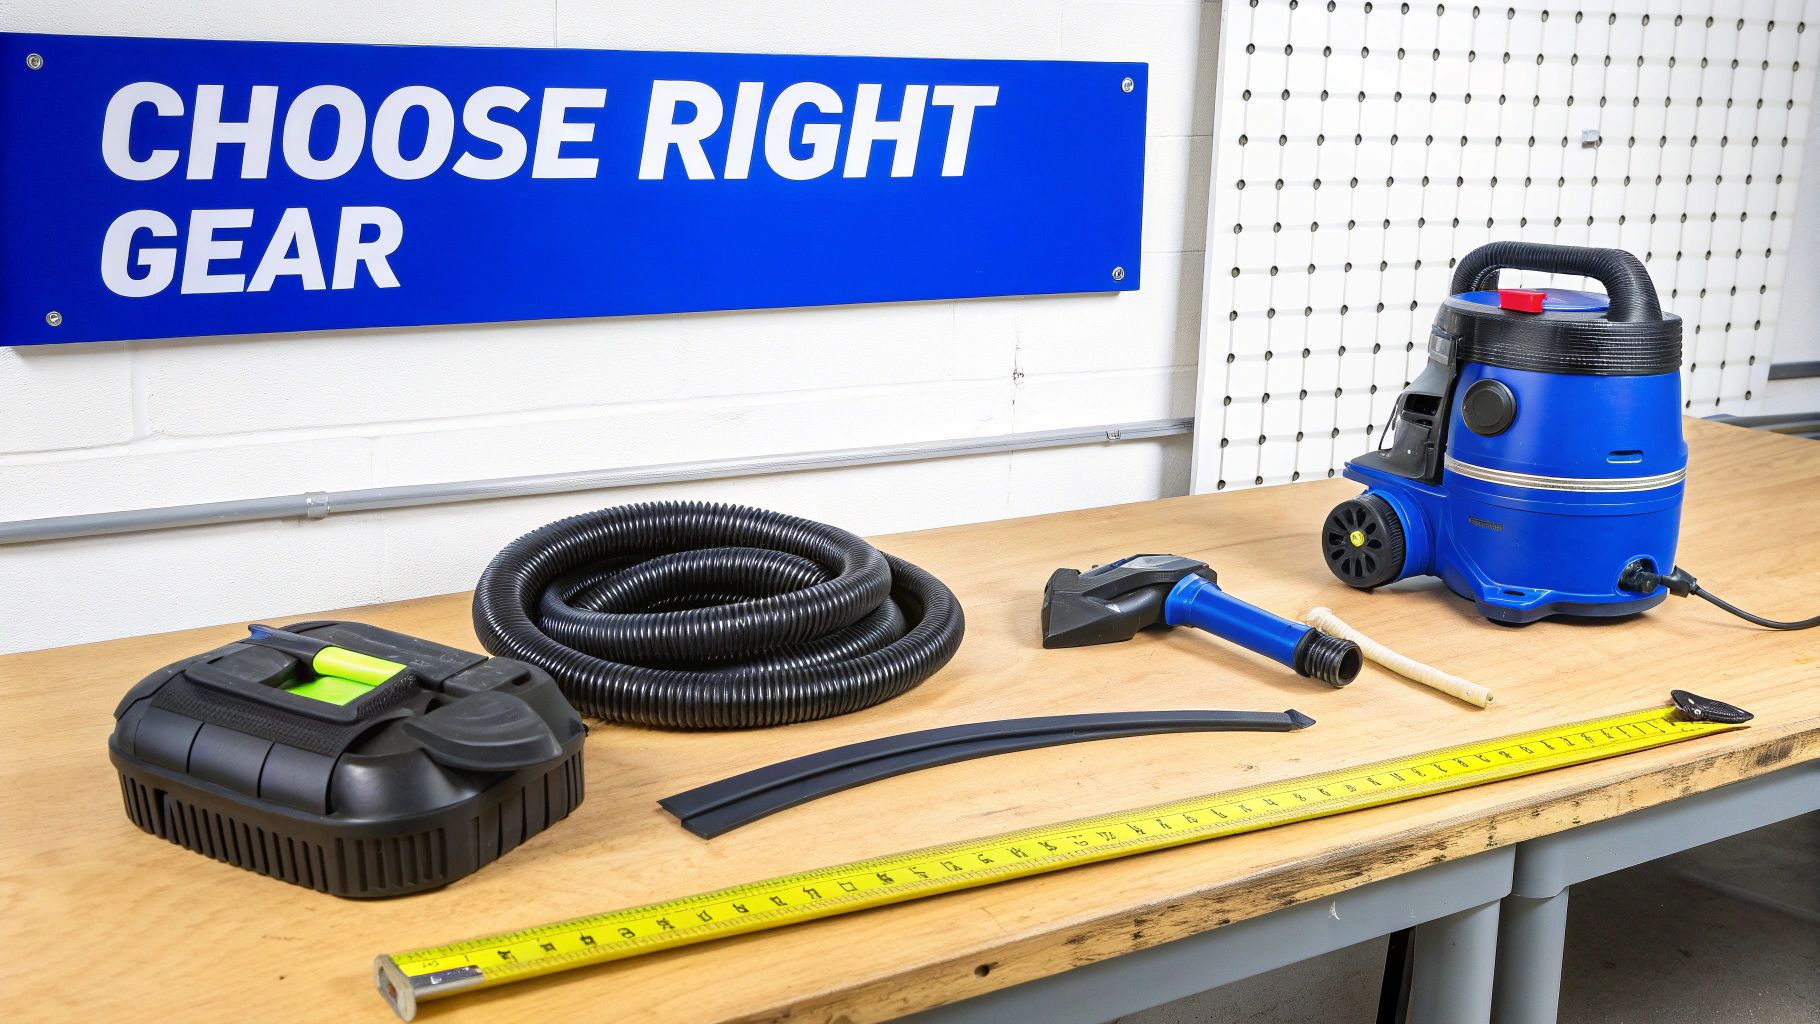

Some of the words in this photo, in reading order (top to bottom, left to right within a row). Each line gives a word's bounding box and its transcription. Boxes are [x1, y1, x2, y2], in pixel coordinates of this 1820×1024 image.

[101, 81, 608, 181] CHOOSE
[638, 79, 1000, 181] RIGHT
[100, 206, 404, 298] GEAR
